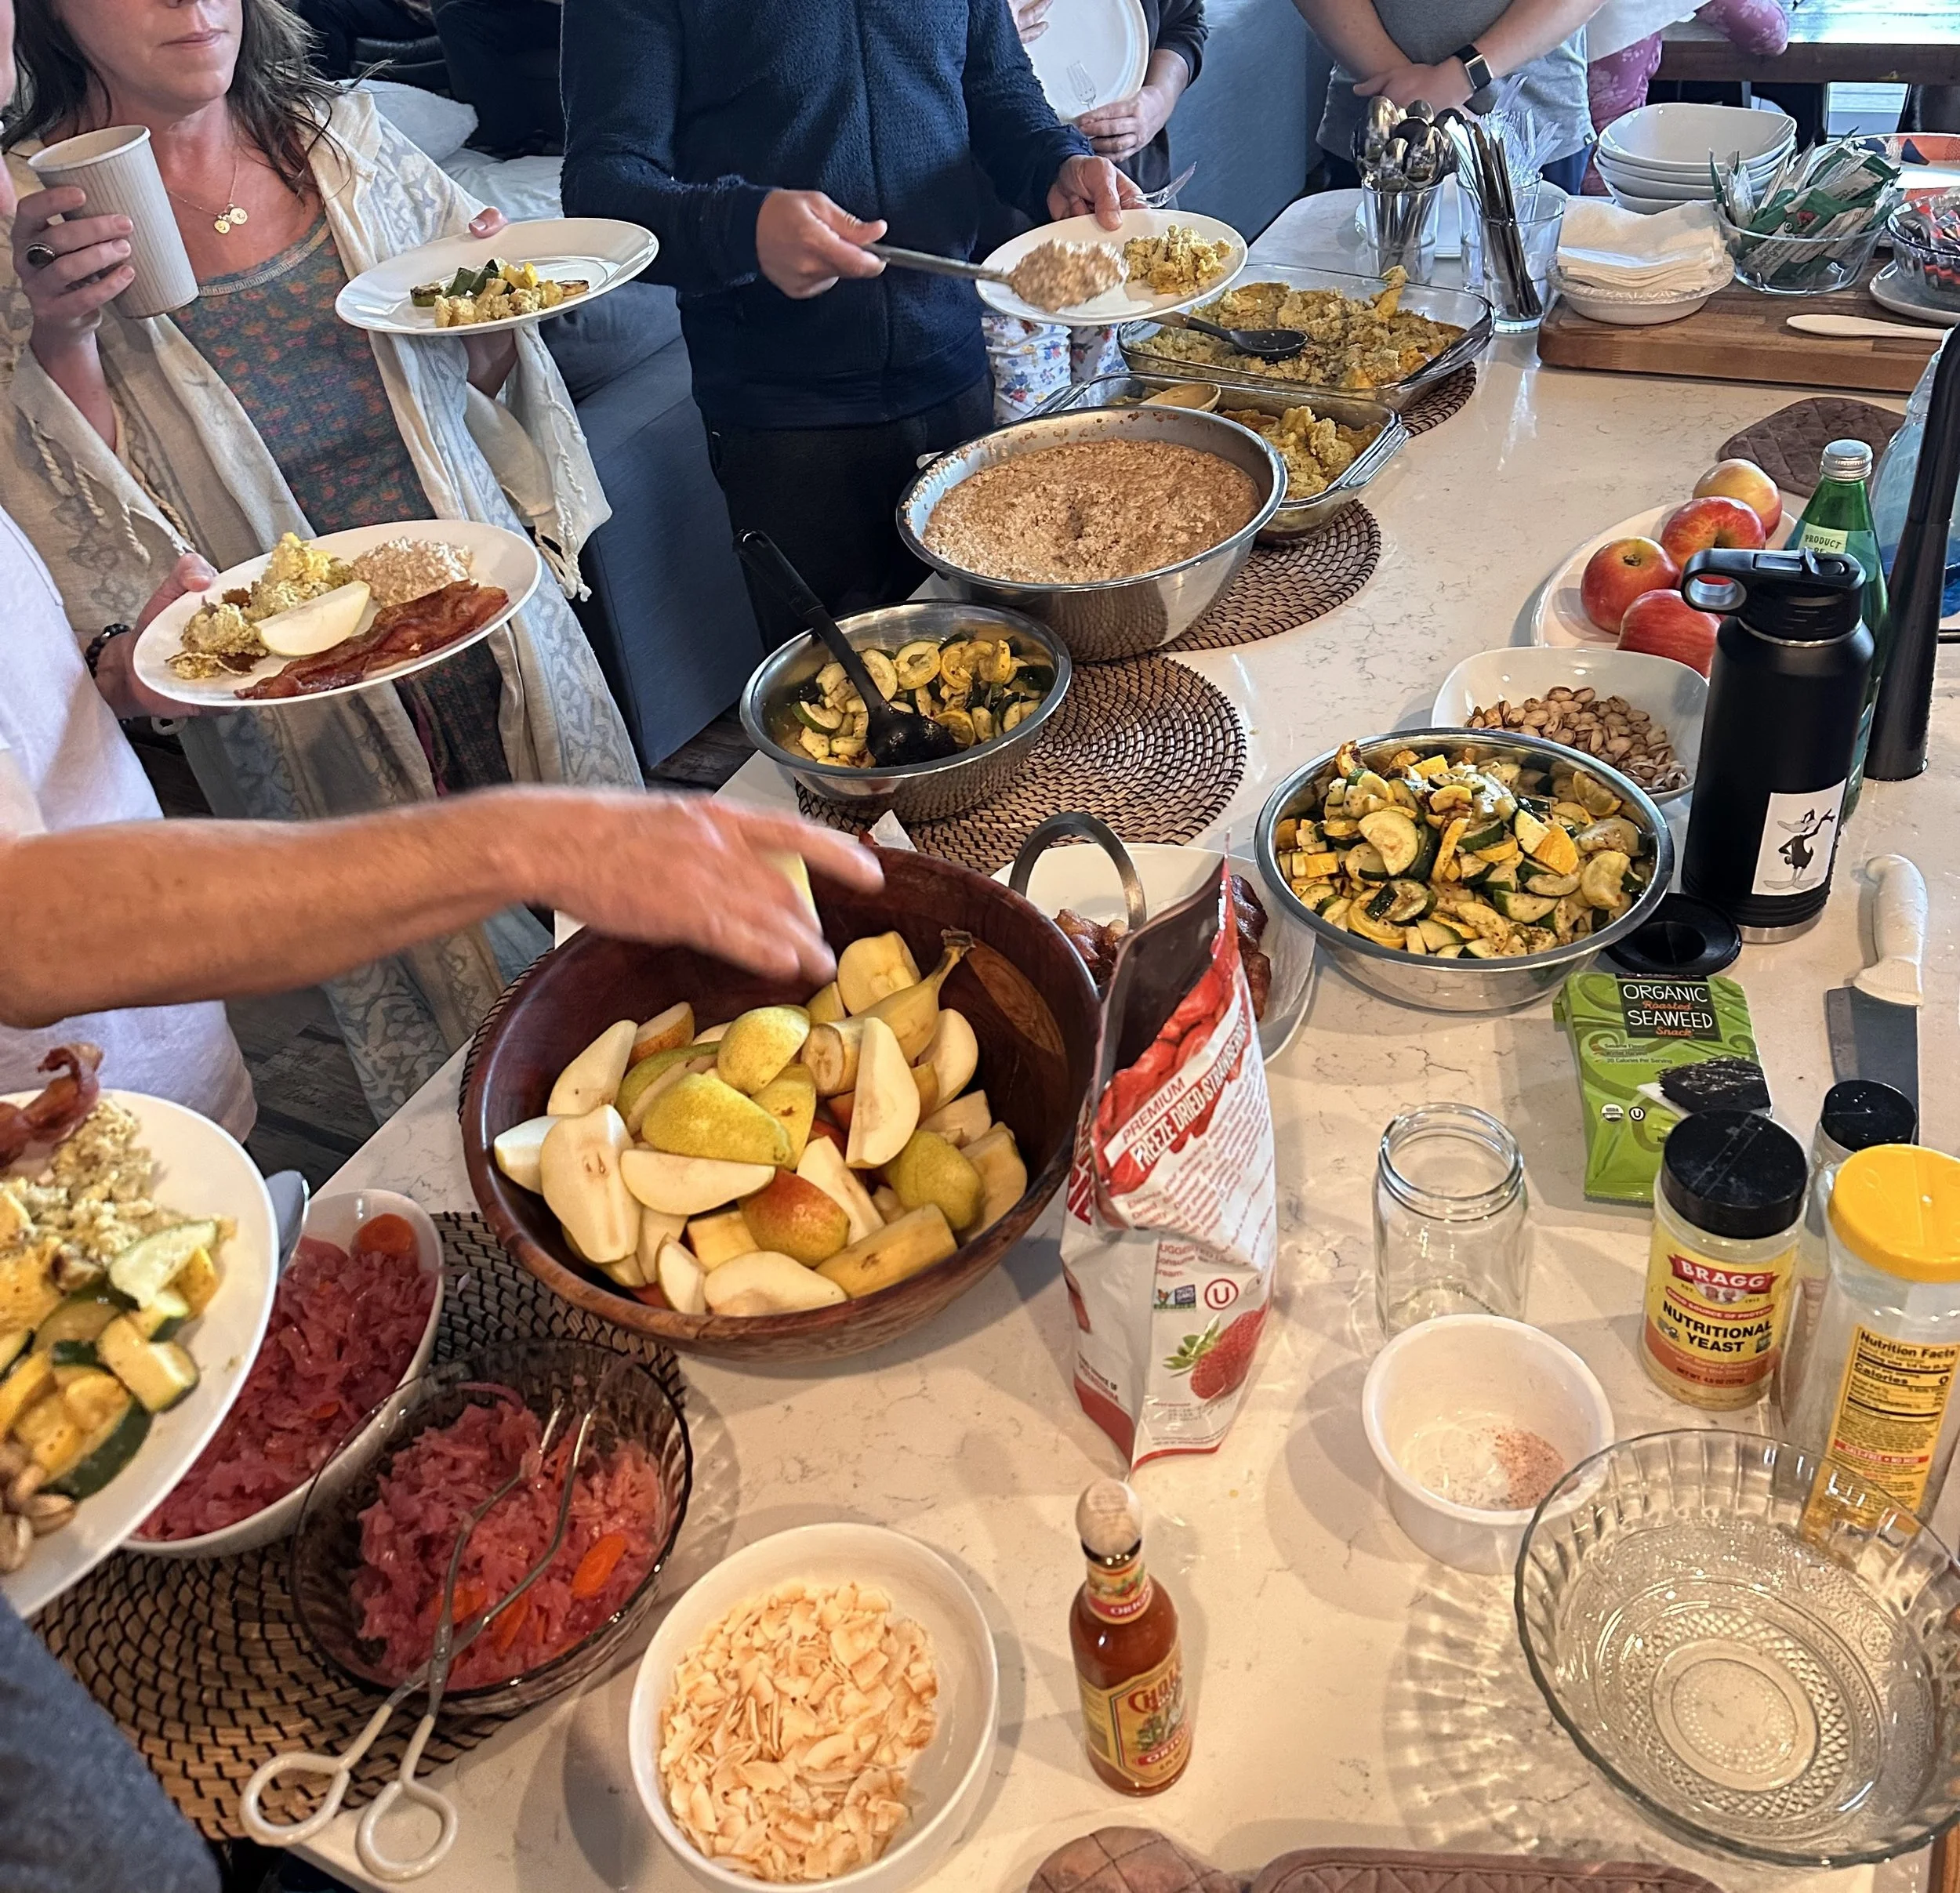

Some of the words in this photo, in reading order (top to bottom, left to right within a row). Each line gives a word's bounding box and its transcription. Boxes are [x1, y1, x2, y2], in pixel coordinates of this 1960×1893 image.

[1805, 535, 1841, 549] PRODUCT
[1623, 985, 1708, 1003] ORGANIC
[1642, 1000, 1693, 1011] Roasted
[1628, 1010, 1712, 1028] SEAWEED
[1654, 1025, 1692, 1036] Snack
[1120, 1076, 1185, 1144] PREMIUM
[1127, 1115, 1179, 1173] FREEZE
[1167, 1086, 1207, 1133] DRIED
[1680, 1260, 1766, 1288] BRAGG
[1663, 1300, 1772, 1339] NUTRITIONAL
[1689, 1303, 1722, 1318] SOURCE
[1686, 1331, 1745, 1352] YEAST
[1860, 1331, 1917, 1357] Nutrition
[1921, 1348, 1955, 1358] Facts
[1855, 1362, 1908, 1384] Calories
[1939, 1375, 1949, 1386] 0
